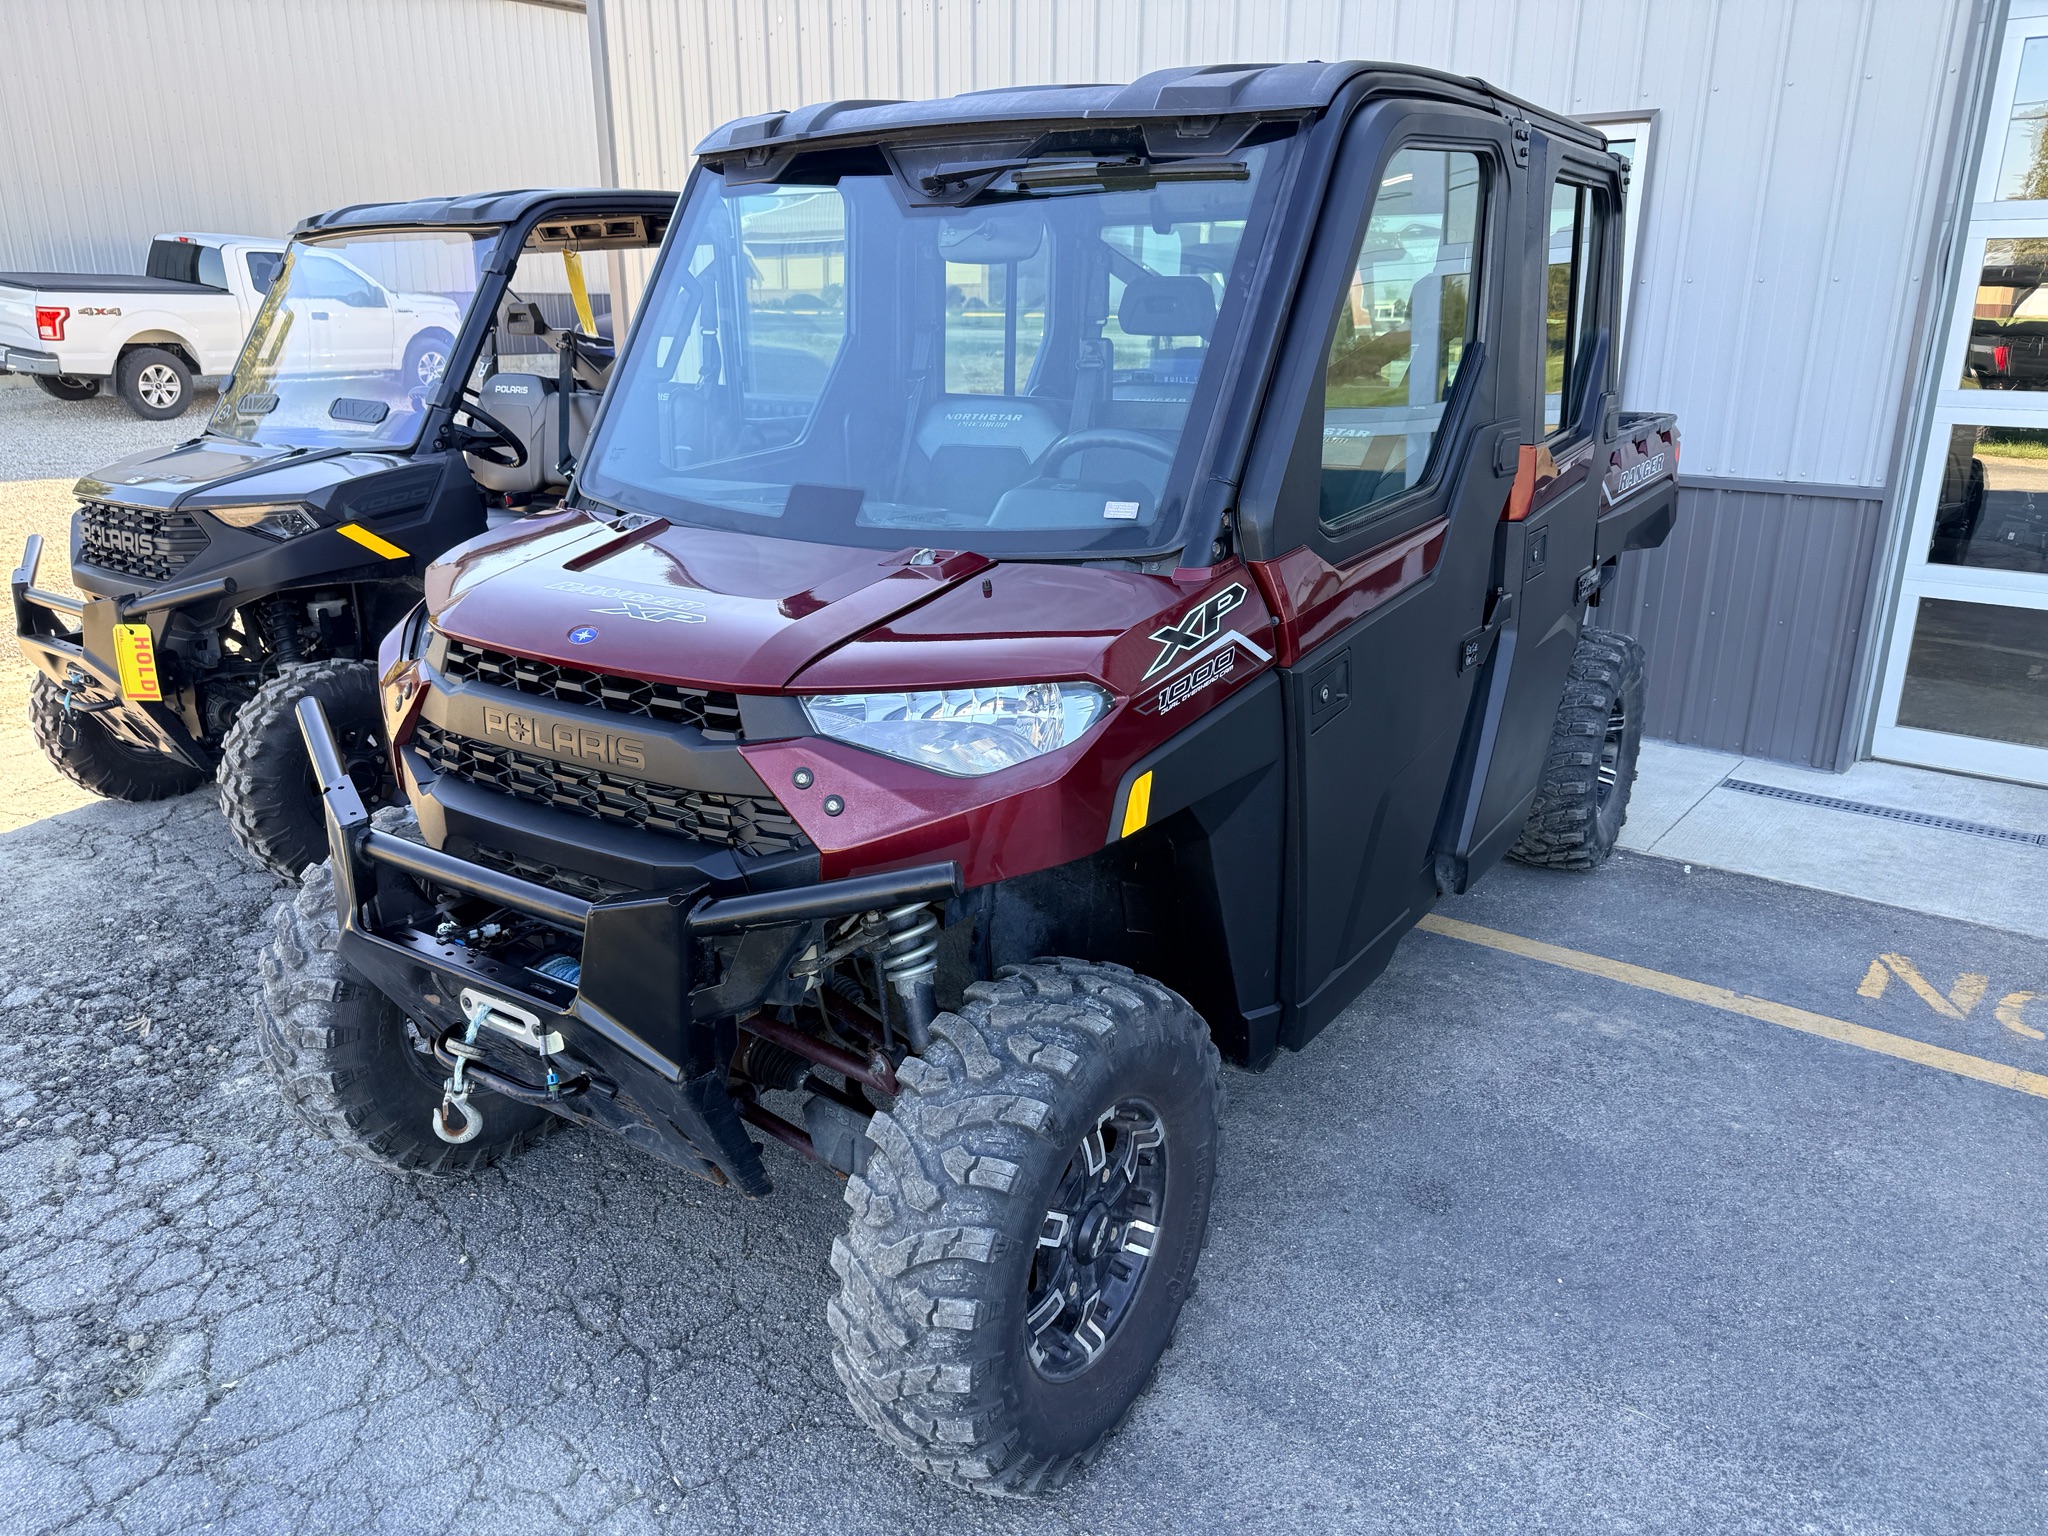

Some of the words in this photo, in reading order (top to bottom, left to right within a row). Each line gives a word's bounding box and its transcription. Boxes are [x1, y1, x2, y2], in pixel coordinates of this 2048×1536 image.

[495, 385, 529, 394] POLARIS
[944, 413, 1023, 421] NORTHSTAR
[1618, 453, 1665, 493] RANGER
[80, 520, 154, 555] POLARIS
[544, 581, 706, 611] RANGER
[588, 602, 707, 624] XP
[1141, 581, 1248, 682] XP
[134, 637, 157, 692] HOLD
[1158, 646, 1236, 711] 1000
[1160, 700, 1181, 716] DUAL
[483, 705, 646, 771] POLARIS
